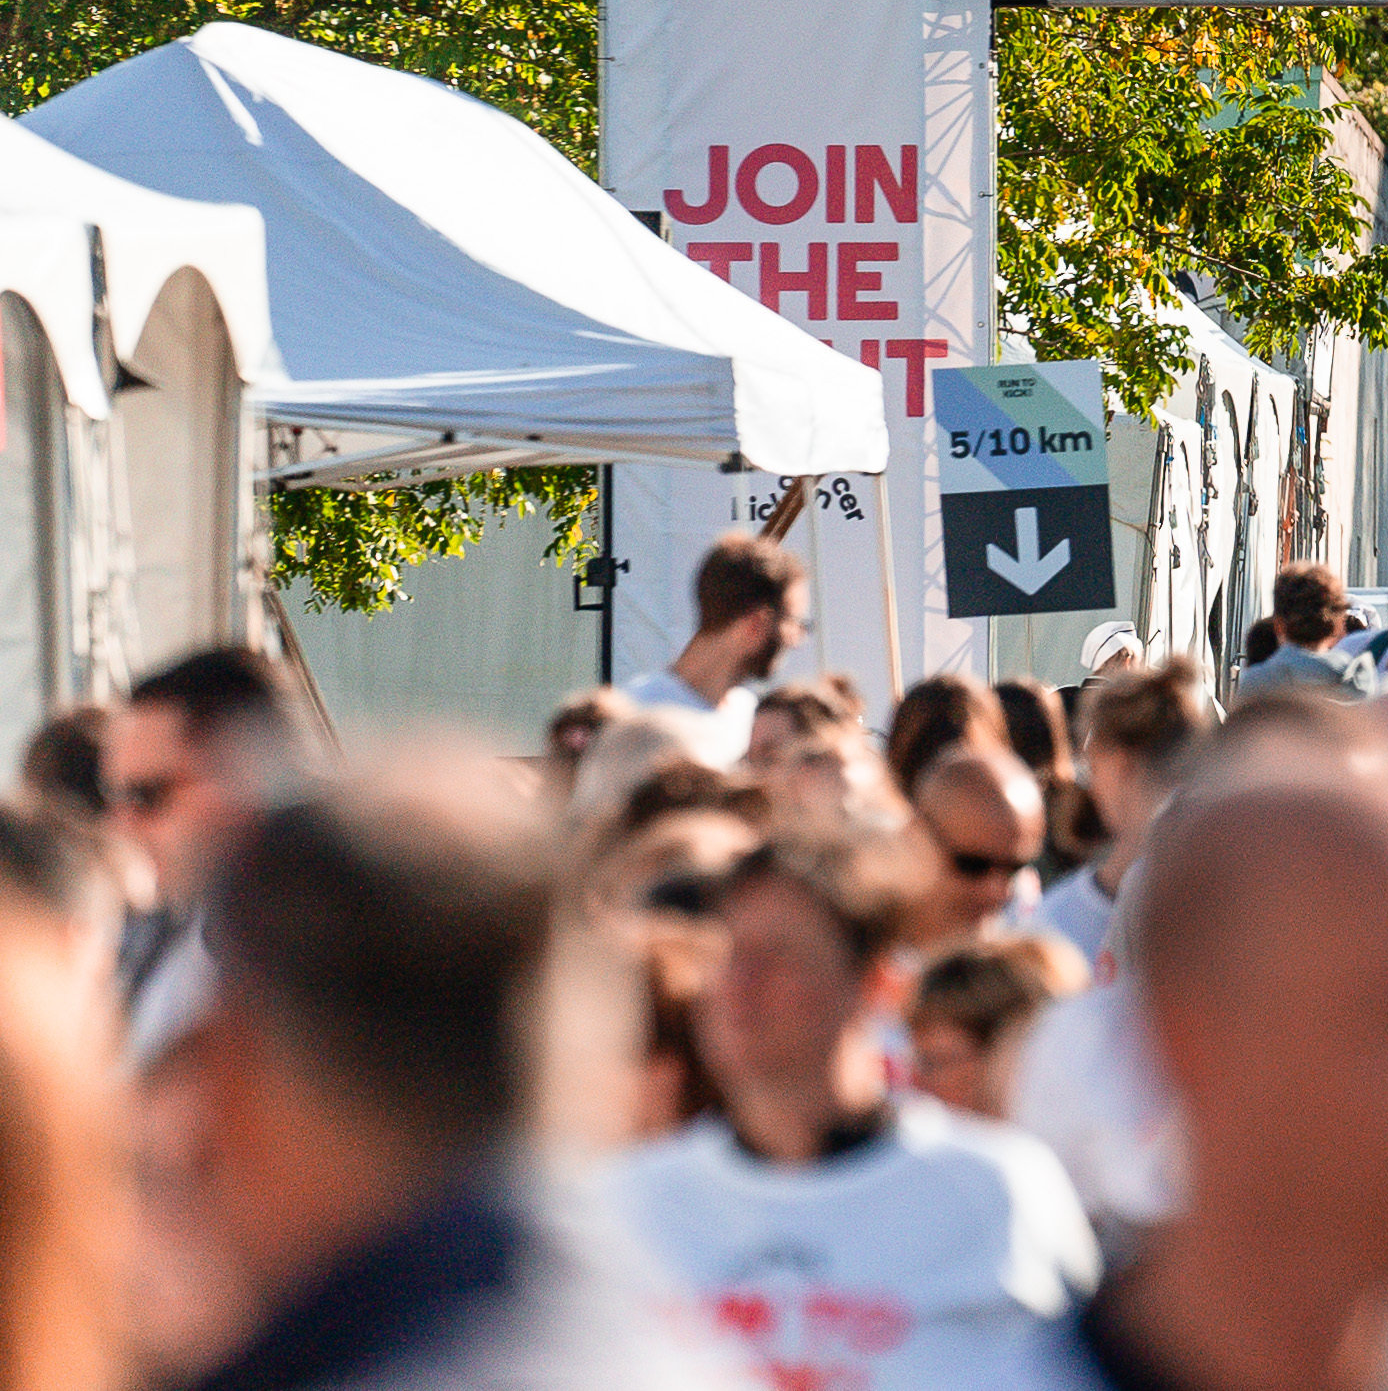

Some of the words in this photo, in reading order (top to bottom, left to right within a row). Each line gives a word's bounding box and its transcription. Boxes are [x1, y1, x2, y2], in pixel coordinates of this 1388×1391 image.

[663, 143, 919, 225] JOIN
[687, 242, 899, 321] THE
[951, 426, 1031, 459] 5/10
[1039, 425, 1093, 454] km
